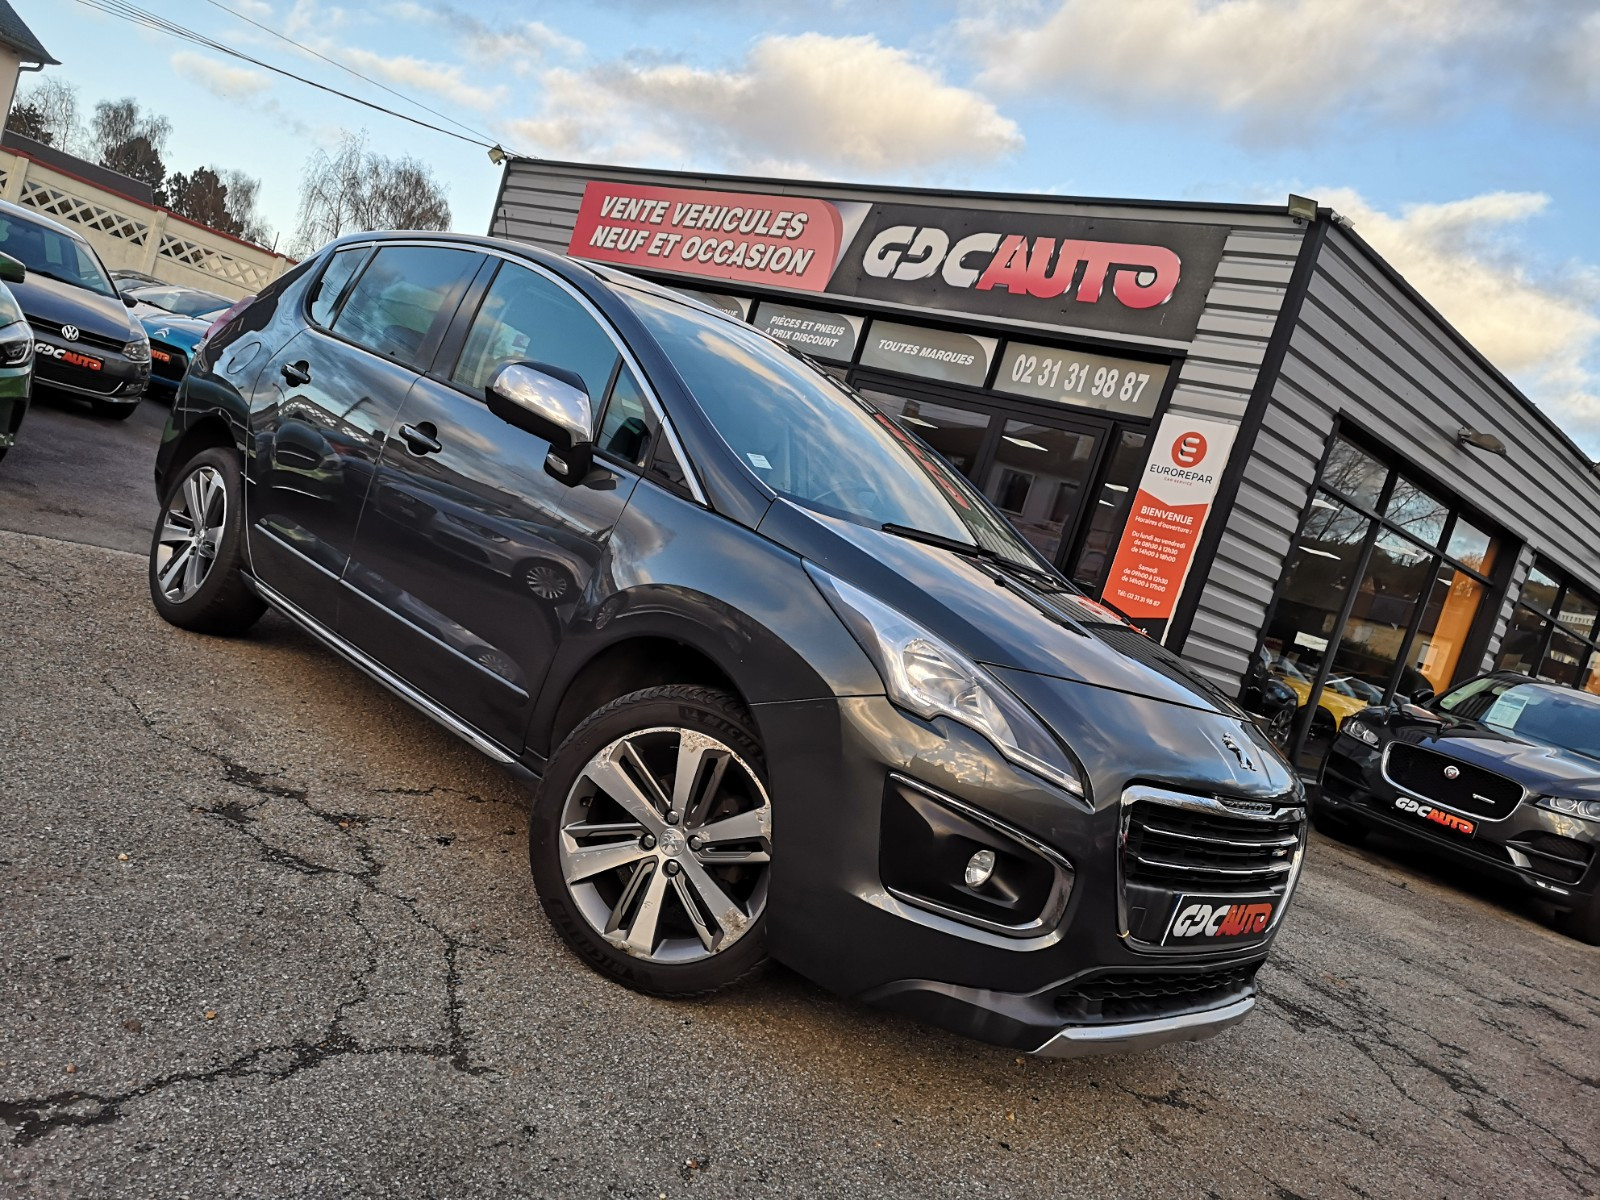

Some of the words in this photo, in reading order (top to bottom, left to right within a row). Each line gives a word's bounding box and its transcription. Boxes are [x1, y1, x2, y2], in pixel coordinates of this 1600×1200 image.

[600, 195, 670, 224] VENTE
[671, 202, 809, 238] VEHICULES
[589, 225, 650, 252] NEUF
[647, 233, 683, 257] ET
[681, 237, 815, 275] OCCASION
[769, 315, 802, 328] PIÈCES
[800, 321, 815, 330] ET
[813, 322, 846, 336] PNEUS
[771, 328, 793, 340] PRIX
[792, 333, 839, 348] DISCOUNT
[878, 339, 920, 355] TOUTES
[919, 347, 975, 365] MARQUES
[1012, 354, 1037, 384] 02
[1037, 358, 1062, 388] 31
[1064, 362, 1090, 392] 31
[1091, 367, 1119, 398] 98
[1119, 372, 1150, 402] 87
[1150, 464, 1213, 484] EUROREPAR
[1134, 516, 1158, 526] Horaires
[1158, 521, 1190, 534] d'ouverture
[1140, 506, 1194, 525] BIENVENUE
[1140, 532, 1154, 540] lundi
[1161, 538, 1186, 549] vendredi
[1138, 548, 1155, 557] 14h00
[1159, 553, 1176, 562] 18h00
[1162, 546, 1178, 555] 12h30
[1131, 570, 1148, 580] 09h00
[1152, 576, 1168, 584] 12h30
[1138, 564, 1158, 574] Samedi
[1129, 577, 1146, 586] 14h00
[1150, 582, 1166, 592] 17h00
